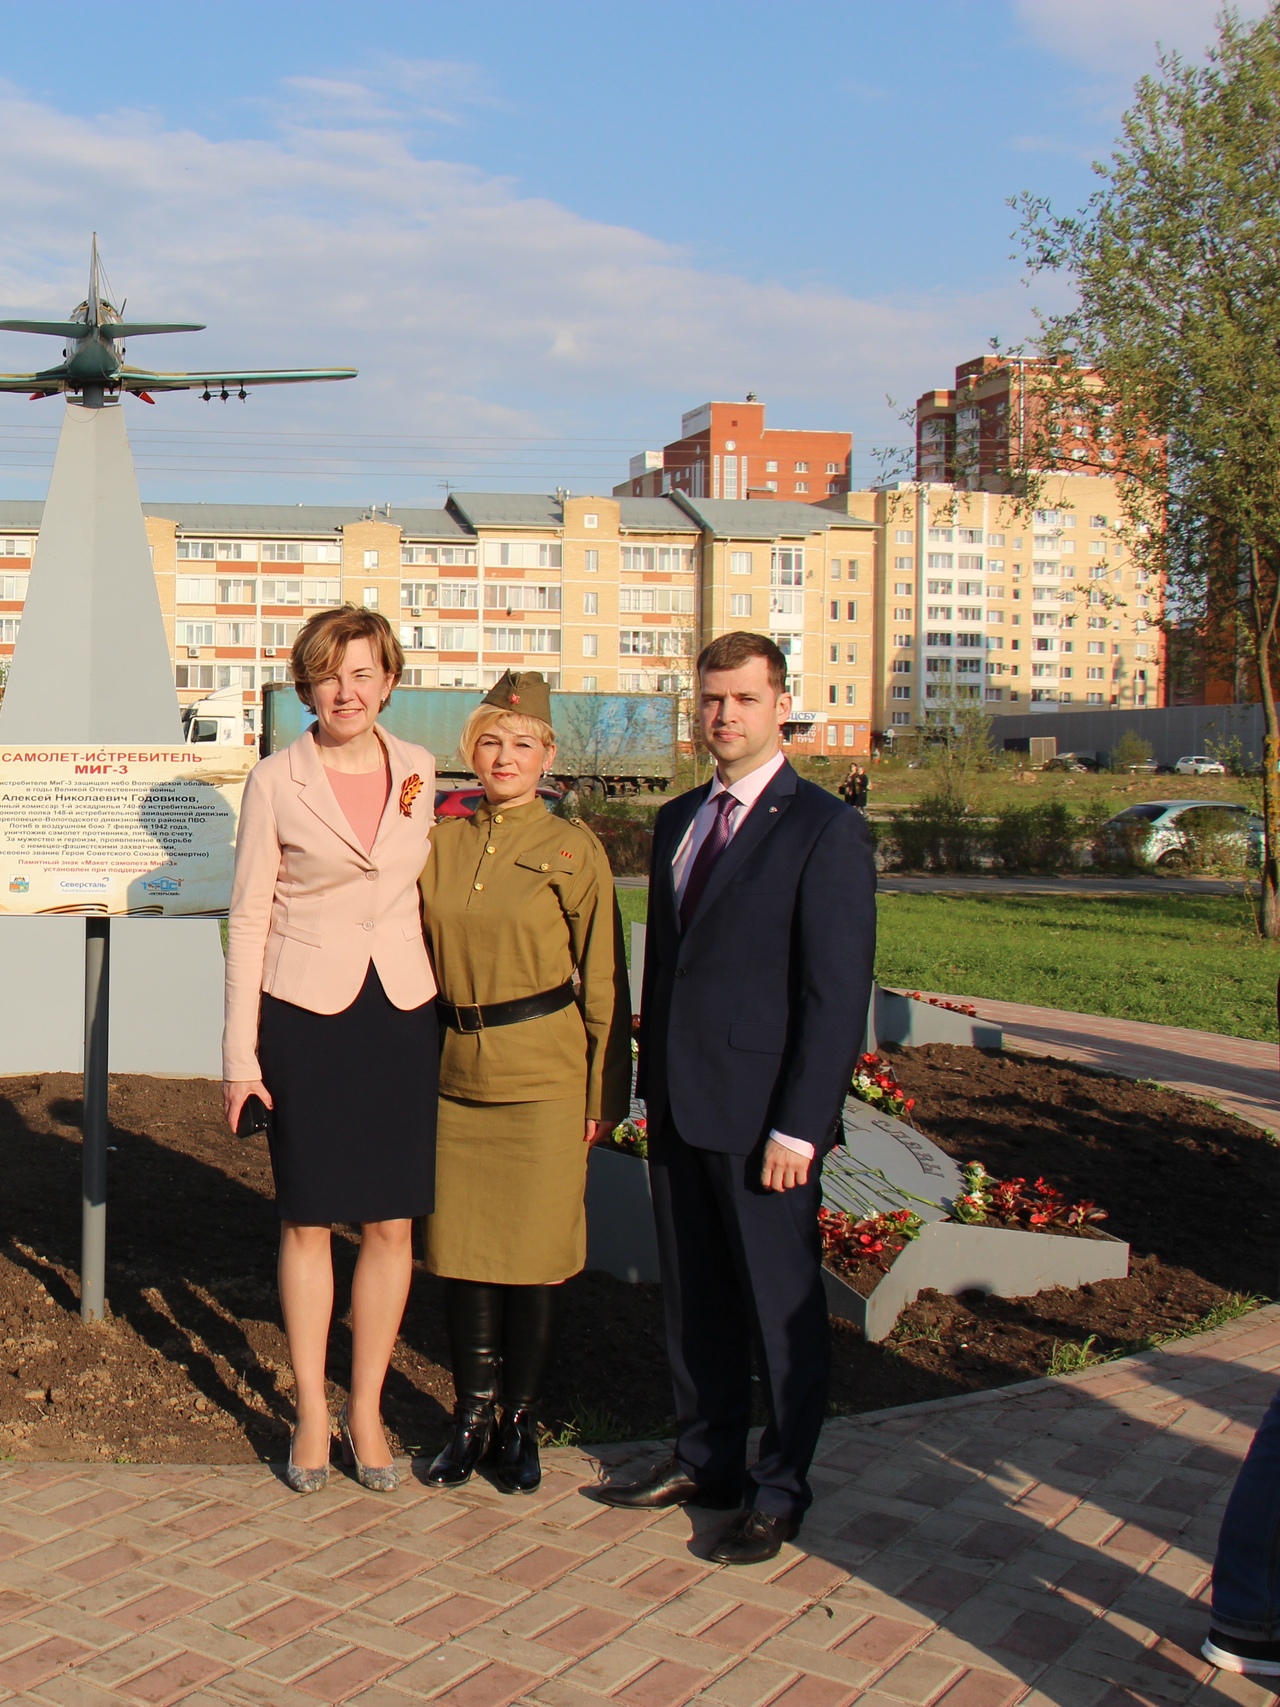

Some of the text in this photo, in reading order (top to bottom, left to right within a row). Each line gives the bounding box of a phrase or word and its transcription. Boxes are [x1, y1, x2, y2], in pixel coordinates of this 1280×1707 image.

[1, 752, 203, 763] САМОЛЕТ-ИСТРЕБИТЕЛЬ
[74, 764, 129, 774] МИГ-3
[1, 794, 199, 802] Алексей Николаевич Годовиков,
